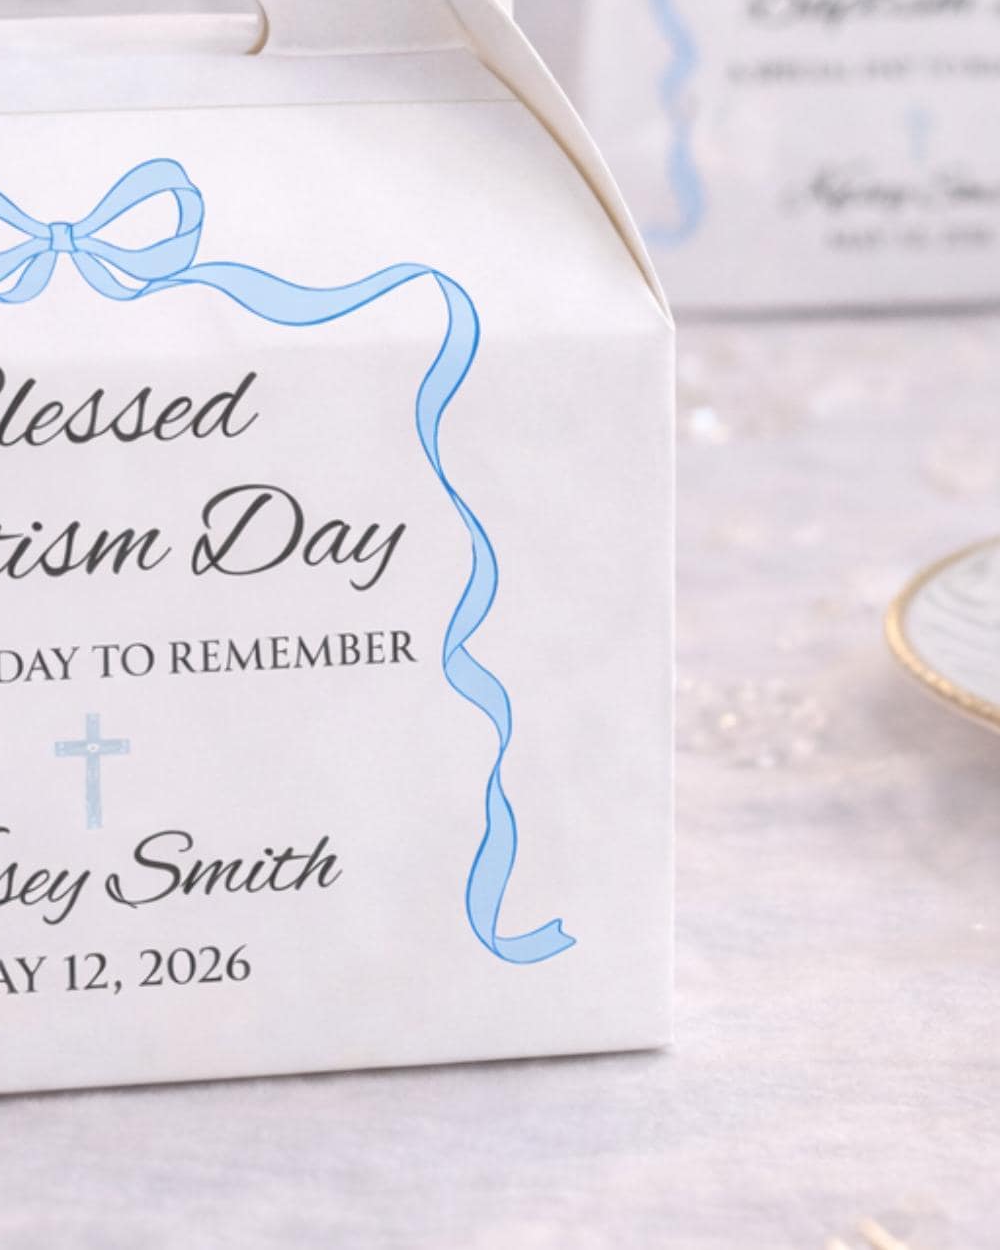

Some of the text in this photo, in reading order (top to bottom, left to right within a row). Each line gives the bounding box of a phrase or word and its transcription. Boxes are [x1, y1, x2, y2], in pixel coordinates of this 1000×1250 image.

[190, 482, 408, 593] Day
[91, 642, 156, 680] TO
[168, 629, 419, 676] REMEMBER
[103, 828, 343, 911] Smith
[64, 951, 124, 996] 12,
[137, 943, 252, 988] 2026
